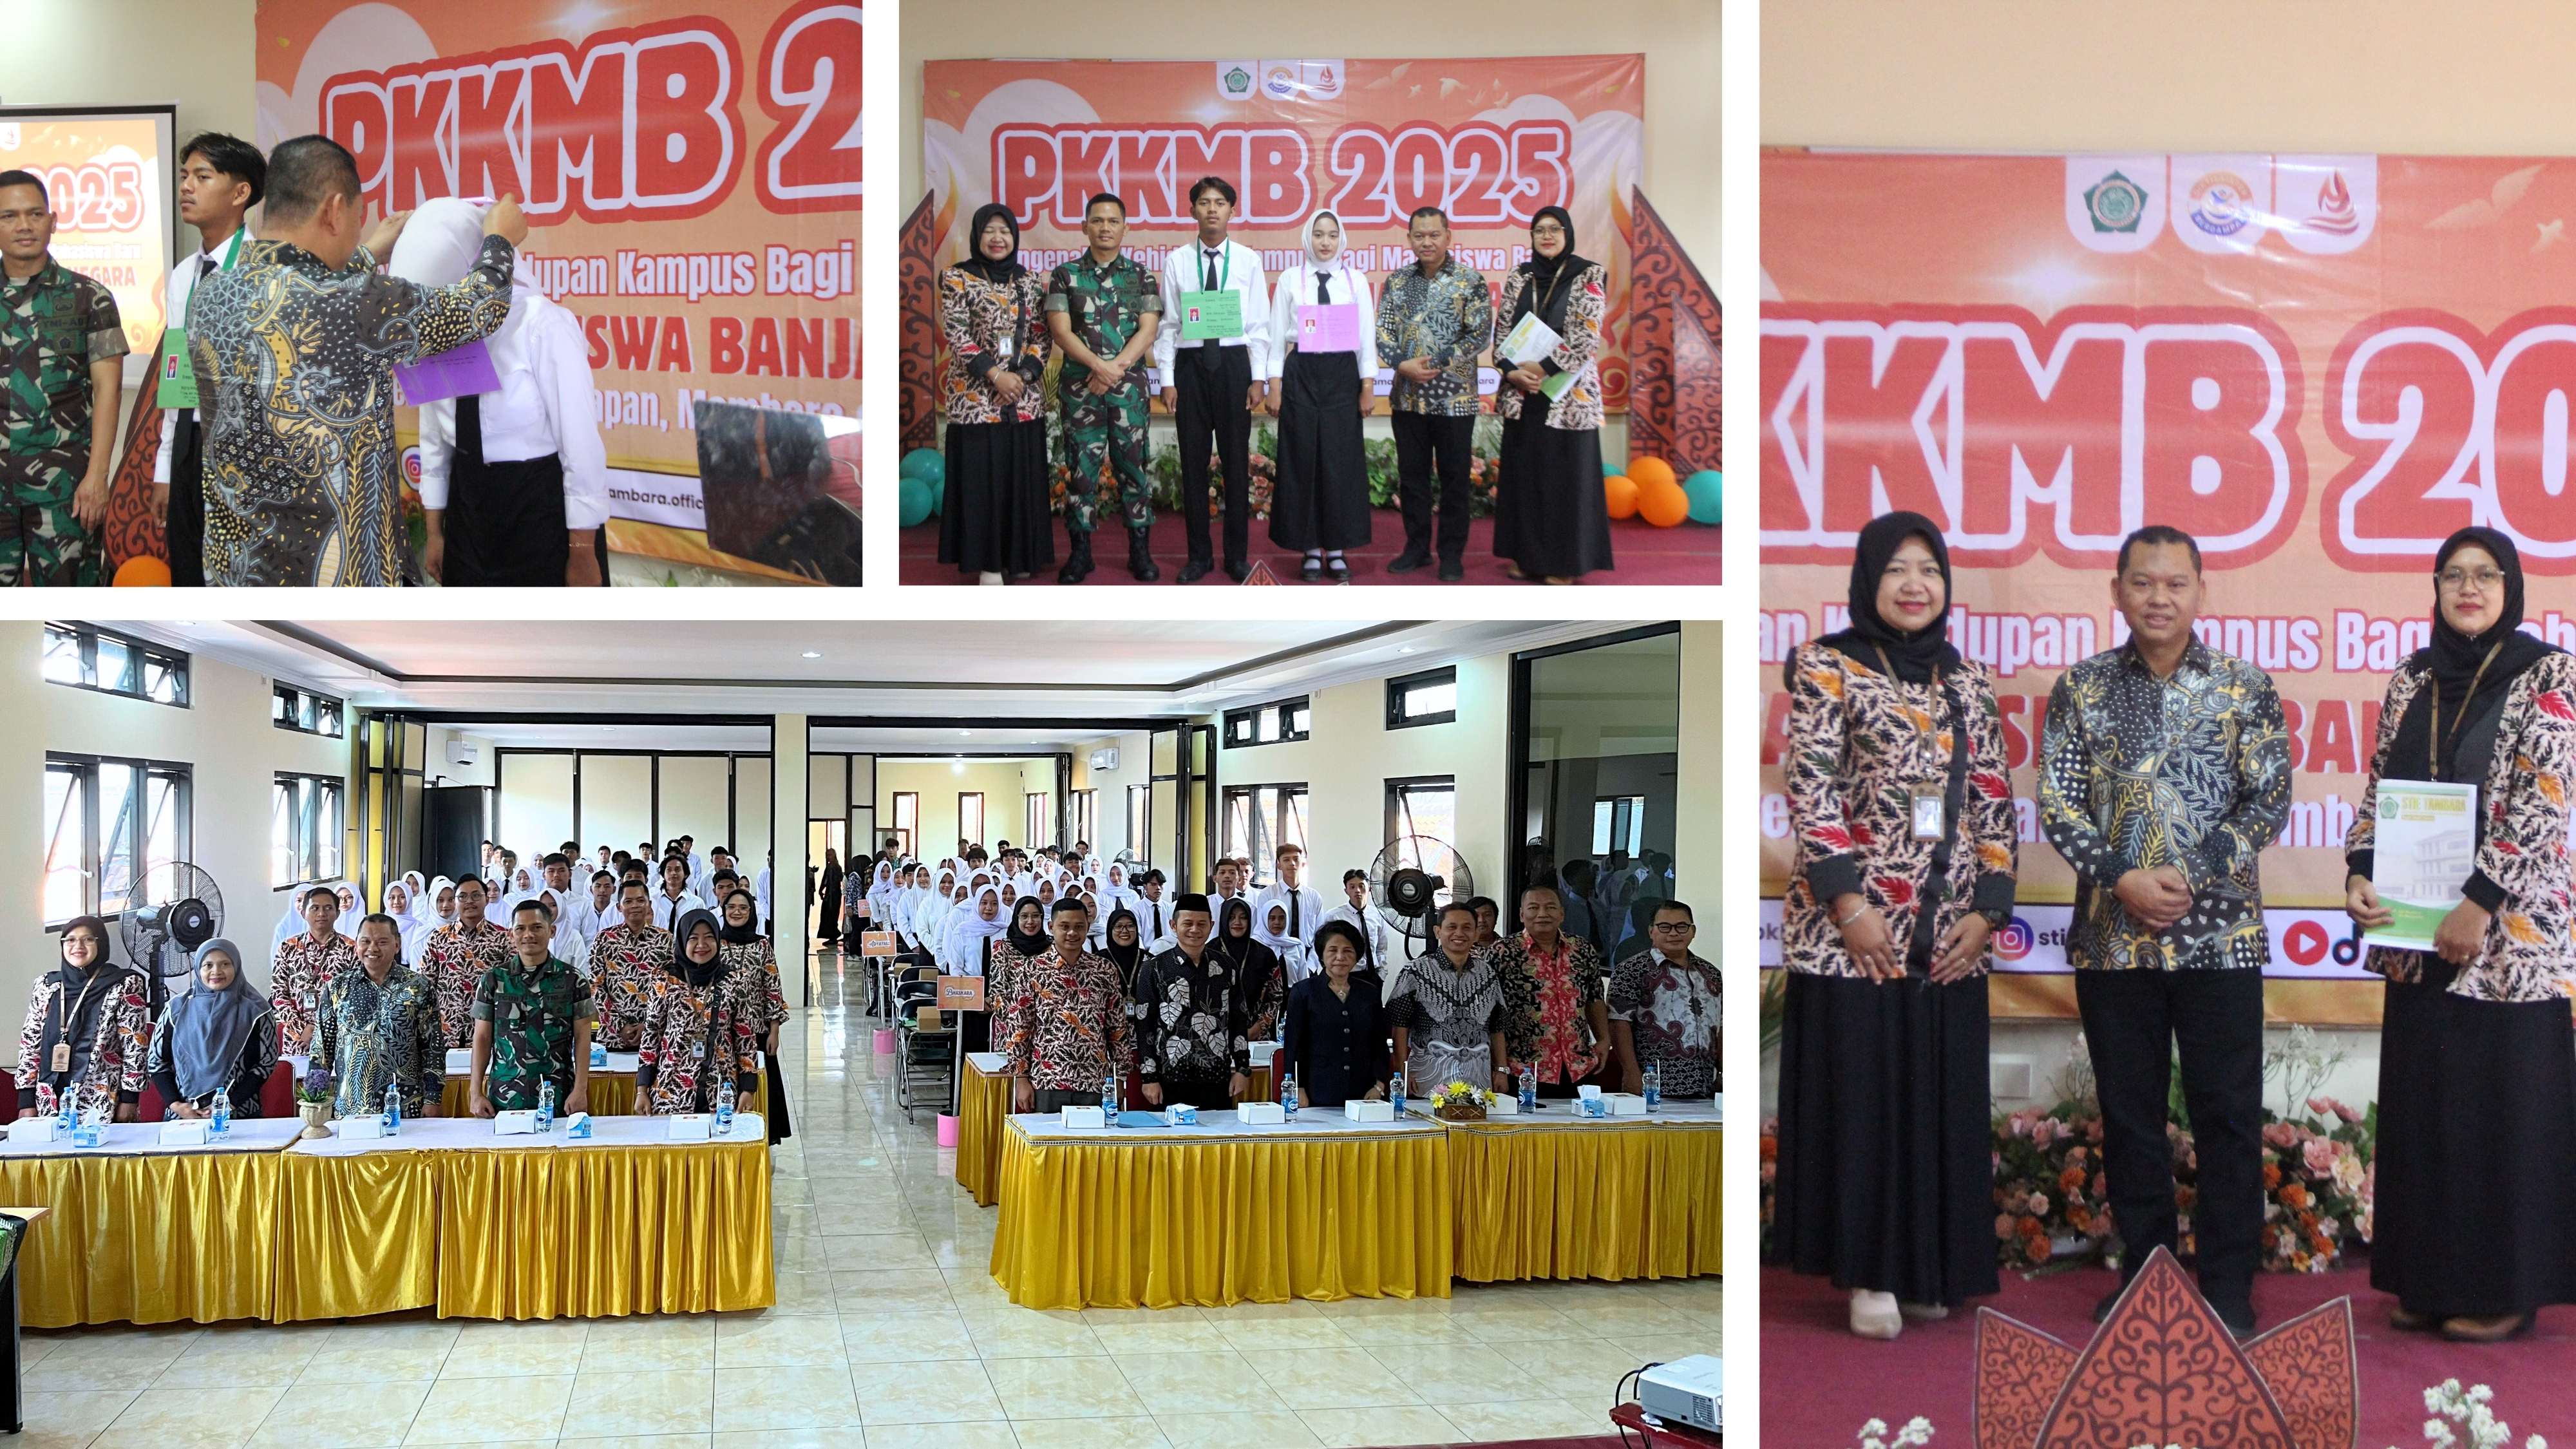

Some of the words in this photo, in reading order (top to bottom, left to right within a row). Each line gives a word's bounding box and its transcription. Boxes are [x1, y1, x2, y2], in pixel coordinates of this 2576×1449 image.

[326, 30, 732, 218] PKKMB
[997, 129, 1311, 223] PKKMB
[1331, 127, 1567, 223] 2025
[616, 249, 755, 303] Kampus
[764, 239, 855, 301] Bagi
